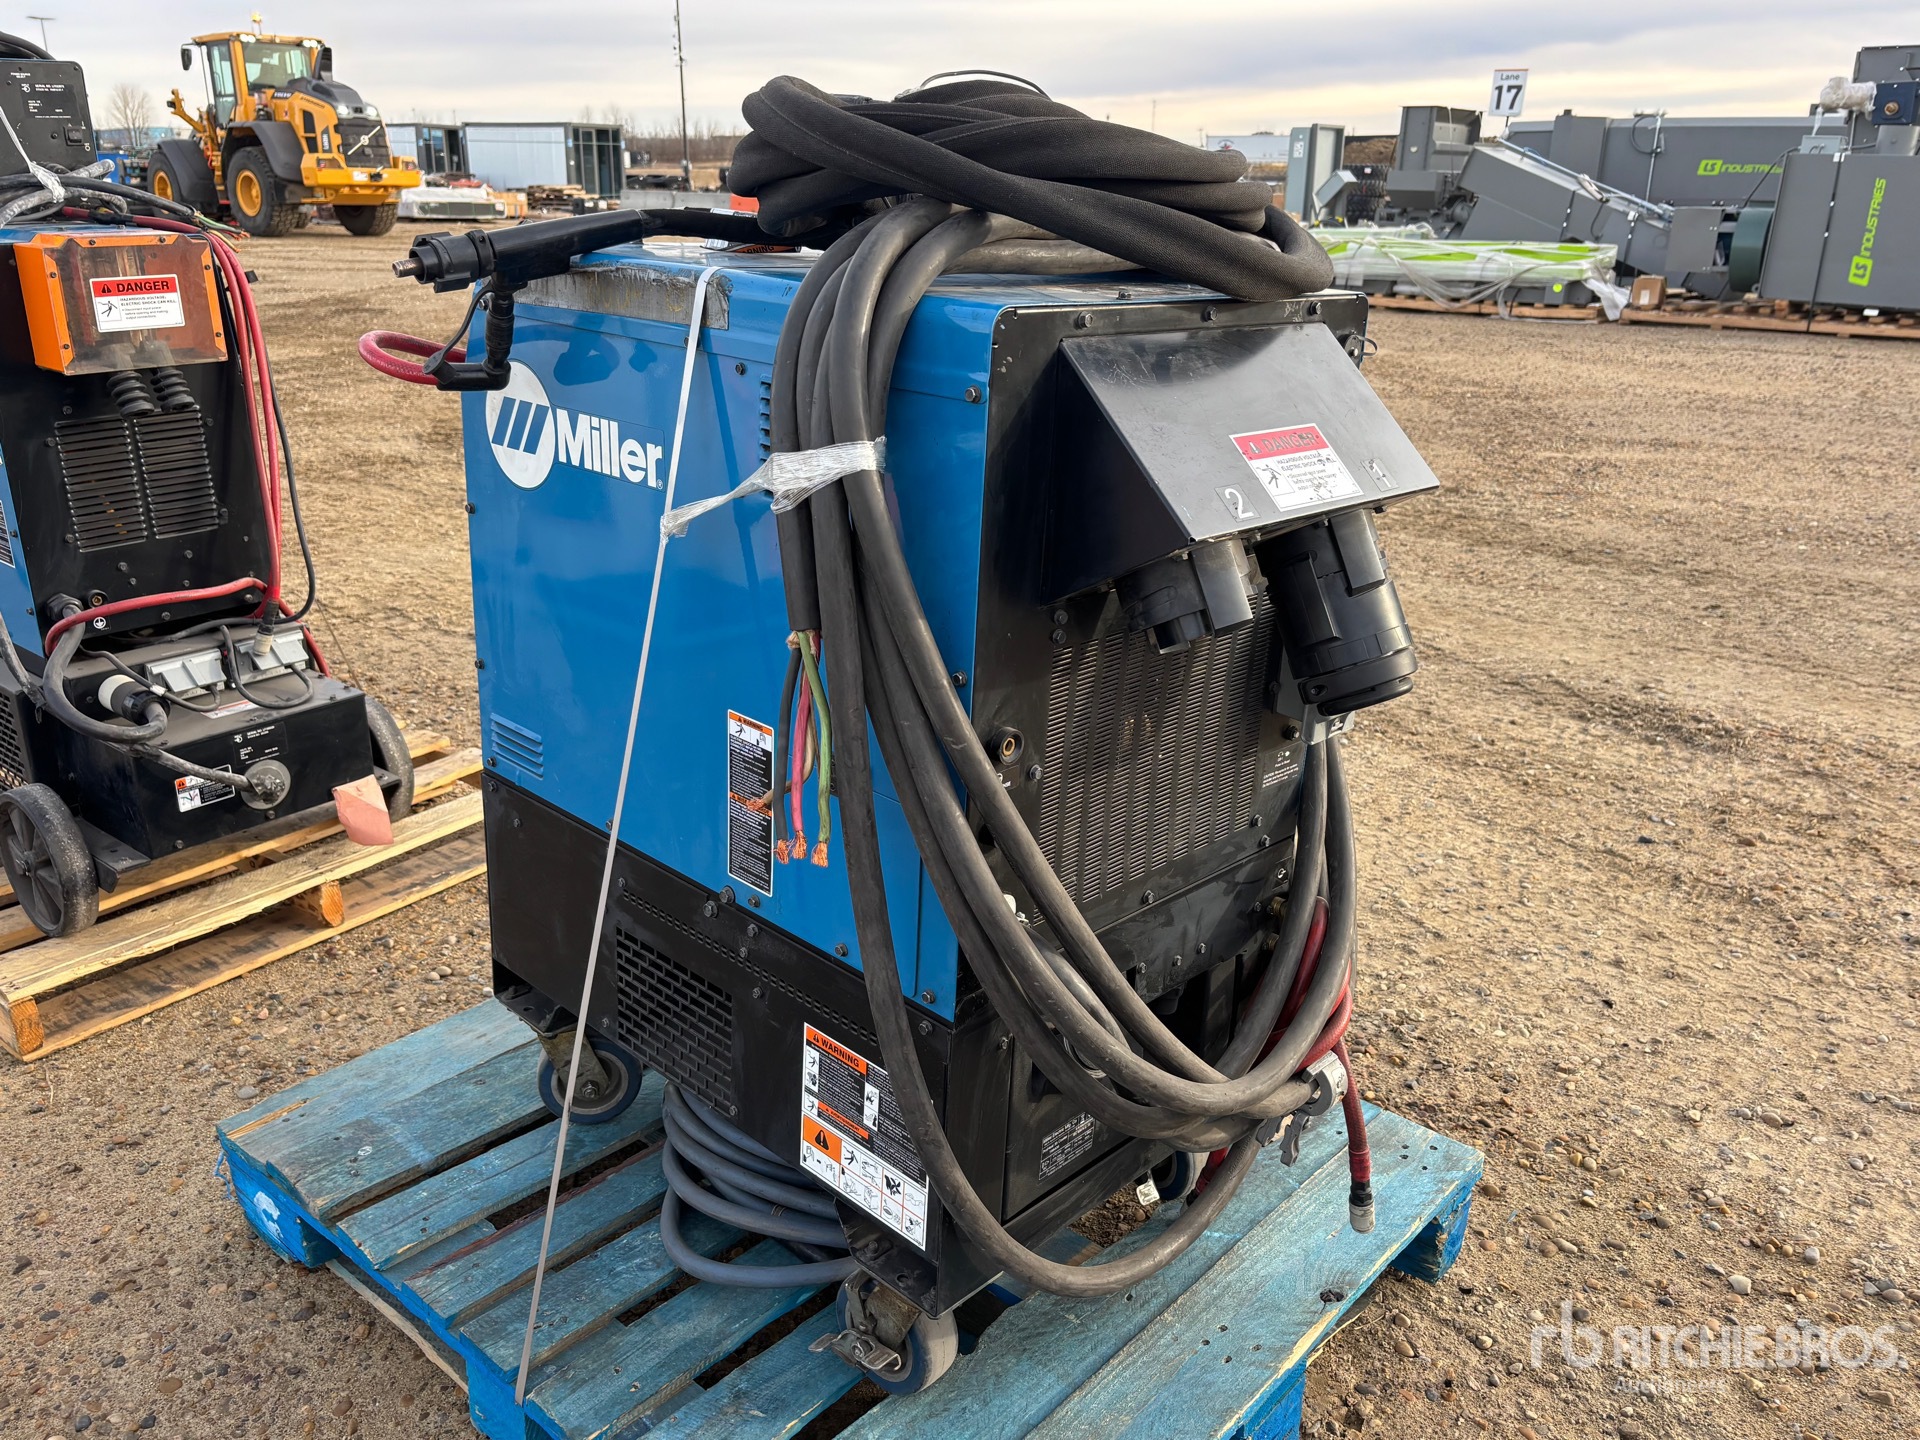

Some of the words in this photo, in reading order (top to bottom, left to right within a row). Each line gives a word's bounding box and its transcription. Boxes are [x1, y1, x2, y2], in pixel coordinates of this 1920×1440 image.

[1500, 73, 1520, 81] Lane
[1494, 84, 1523, 110] 17
[1860, 177, 1887, 257] INDUSTRIES
[116, 281, 170, 293] DANGER
[556, 408, 663, 489] Miller
[1261, 432, 1319, 453] DANGER
[1372, 459, 1392, 488] 1
[1224, 487, 1254, 519] 2
[821, 1037, 860, 1068] WARNING
